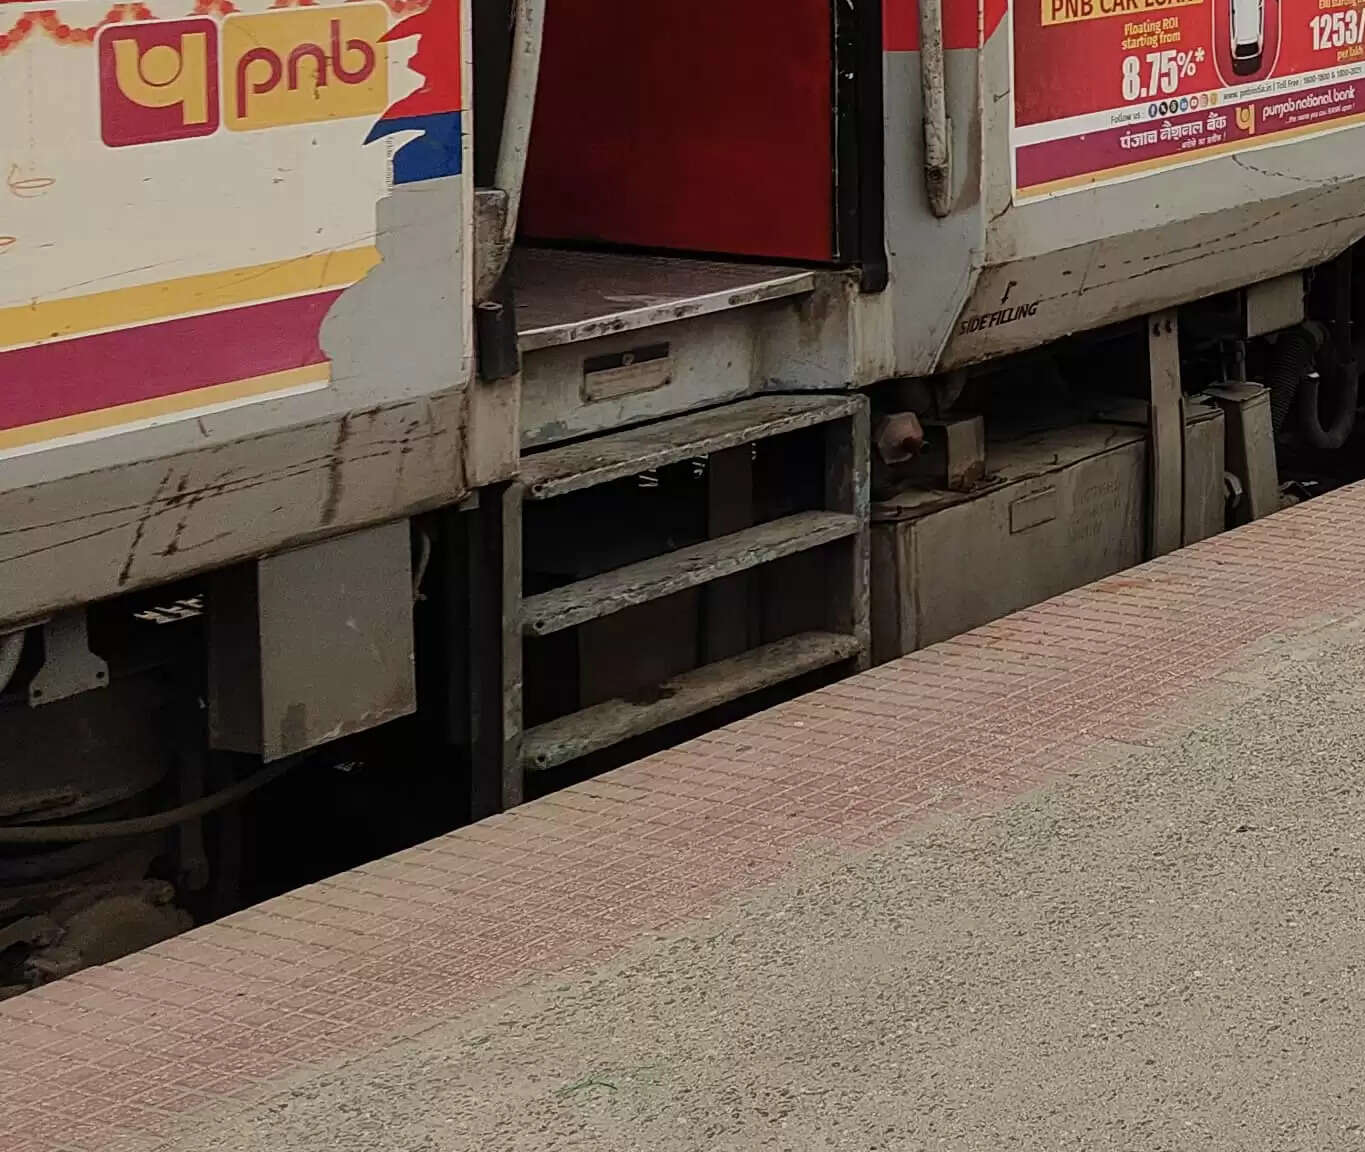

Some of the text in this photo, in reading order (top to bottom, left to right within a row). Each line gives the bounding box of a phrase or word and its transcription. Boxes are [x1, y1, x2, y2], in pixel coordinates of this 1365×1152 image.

[1122, 31, 1180, 50] starting from
[1124, 17, 1179, 36] Floating ROI
[236, 18, 375, 119] pnb
[1263, 85, 1356, 122] punjab national bank
[1120, 130, 1158, 150] पंजाब
[1160, 120, 1203, 141] नैशनल
